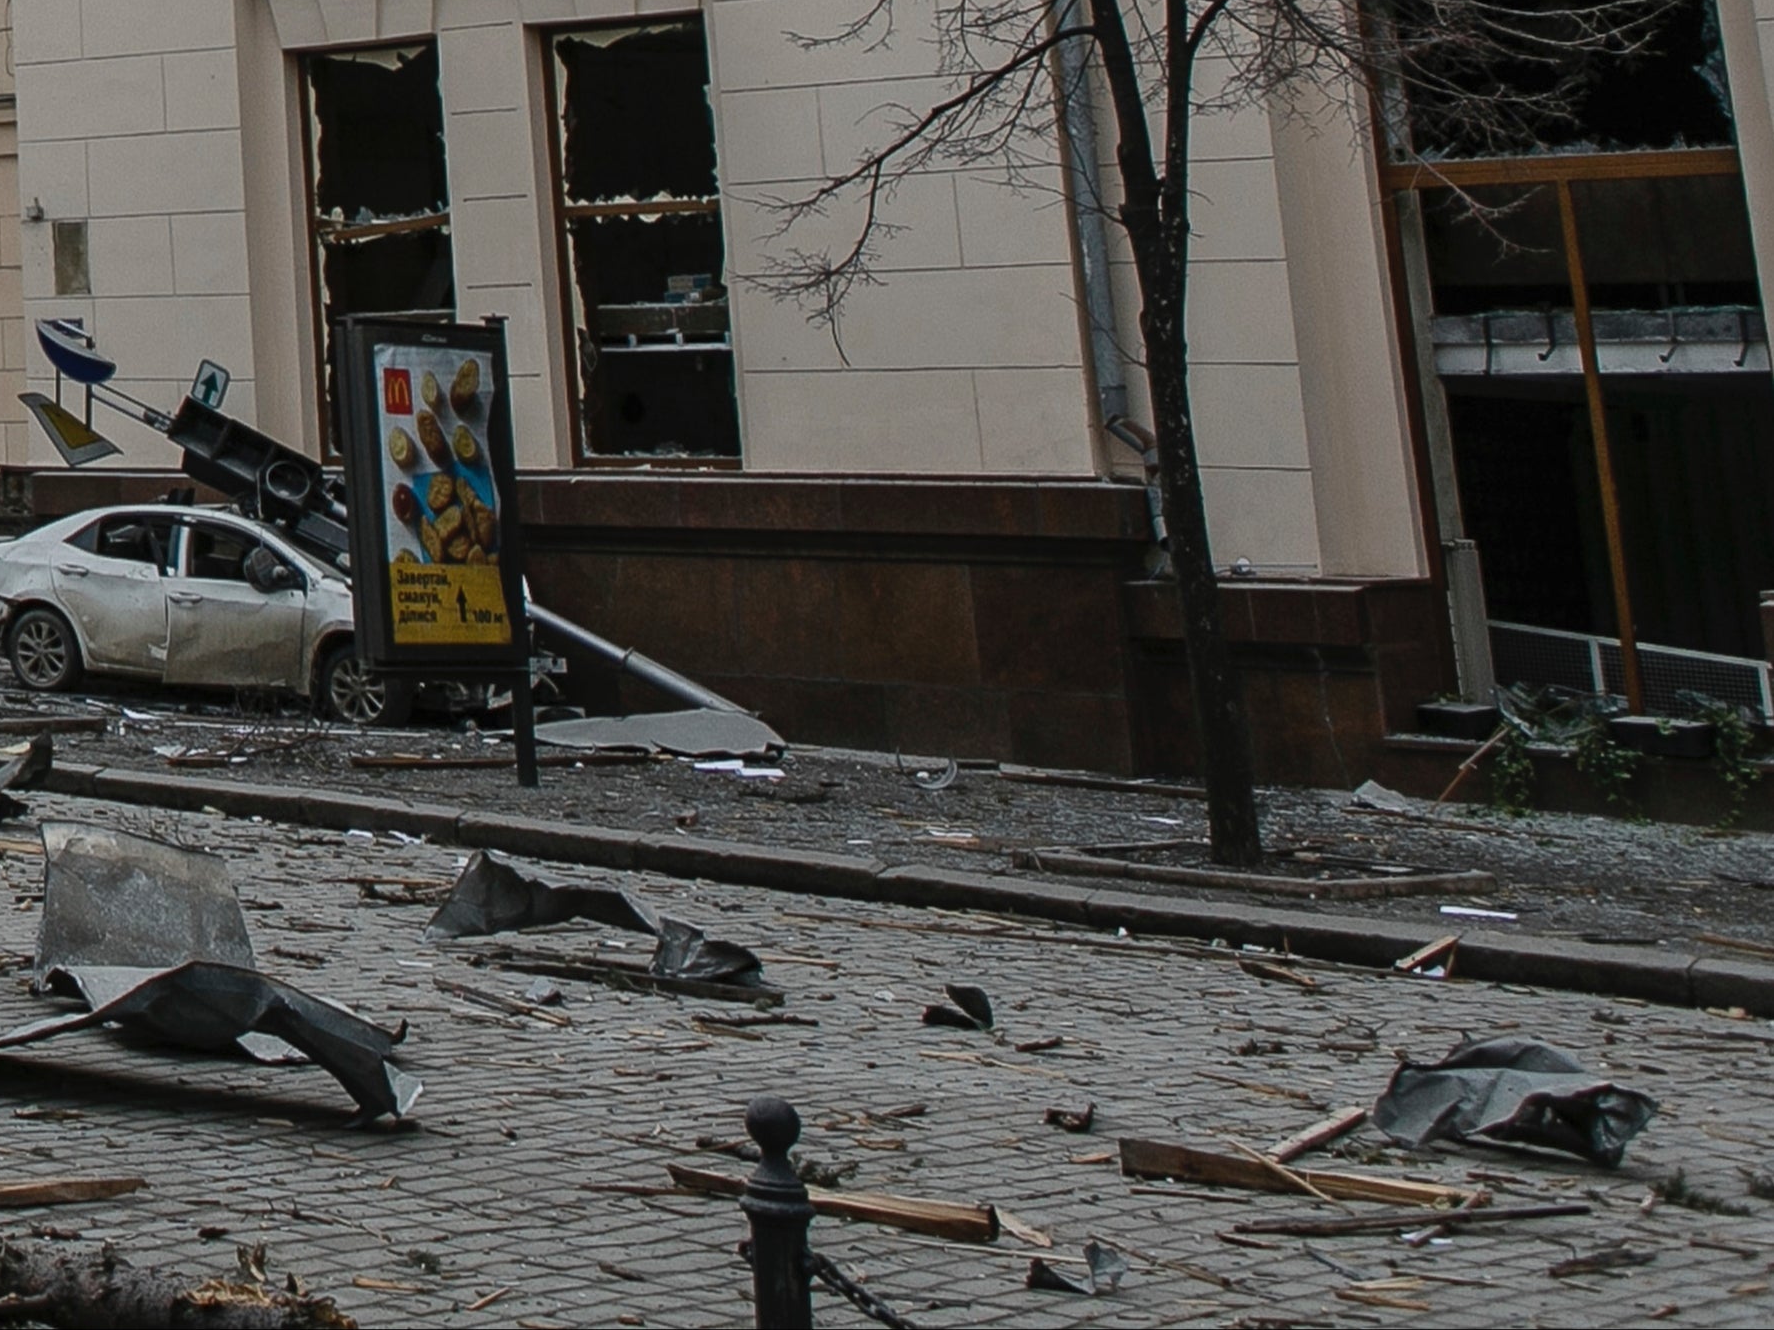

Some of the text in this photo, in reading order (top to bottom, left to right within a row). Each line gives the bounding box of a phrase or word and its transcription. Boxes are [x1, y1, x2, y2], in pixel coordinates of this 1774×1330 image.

[396, 568, 452, 590] Завертай,
[397, 587, 442, 608] смакуй,
[398, 605, 438, 625] ділися
[472, 609, 492, 624] 100
